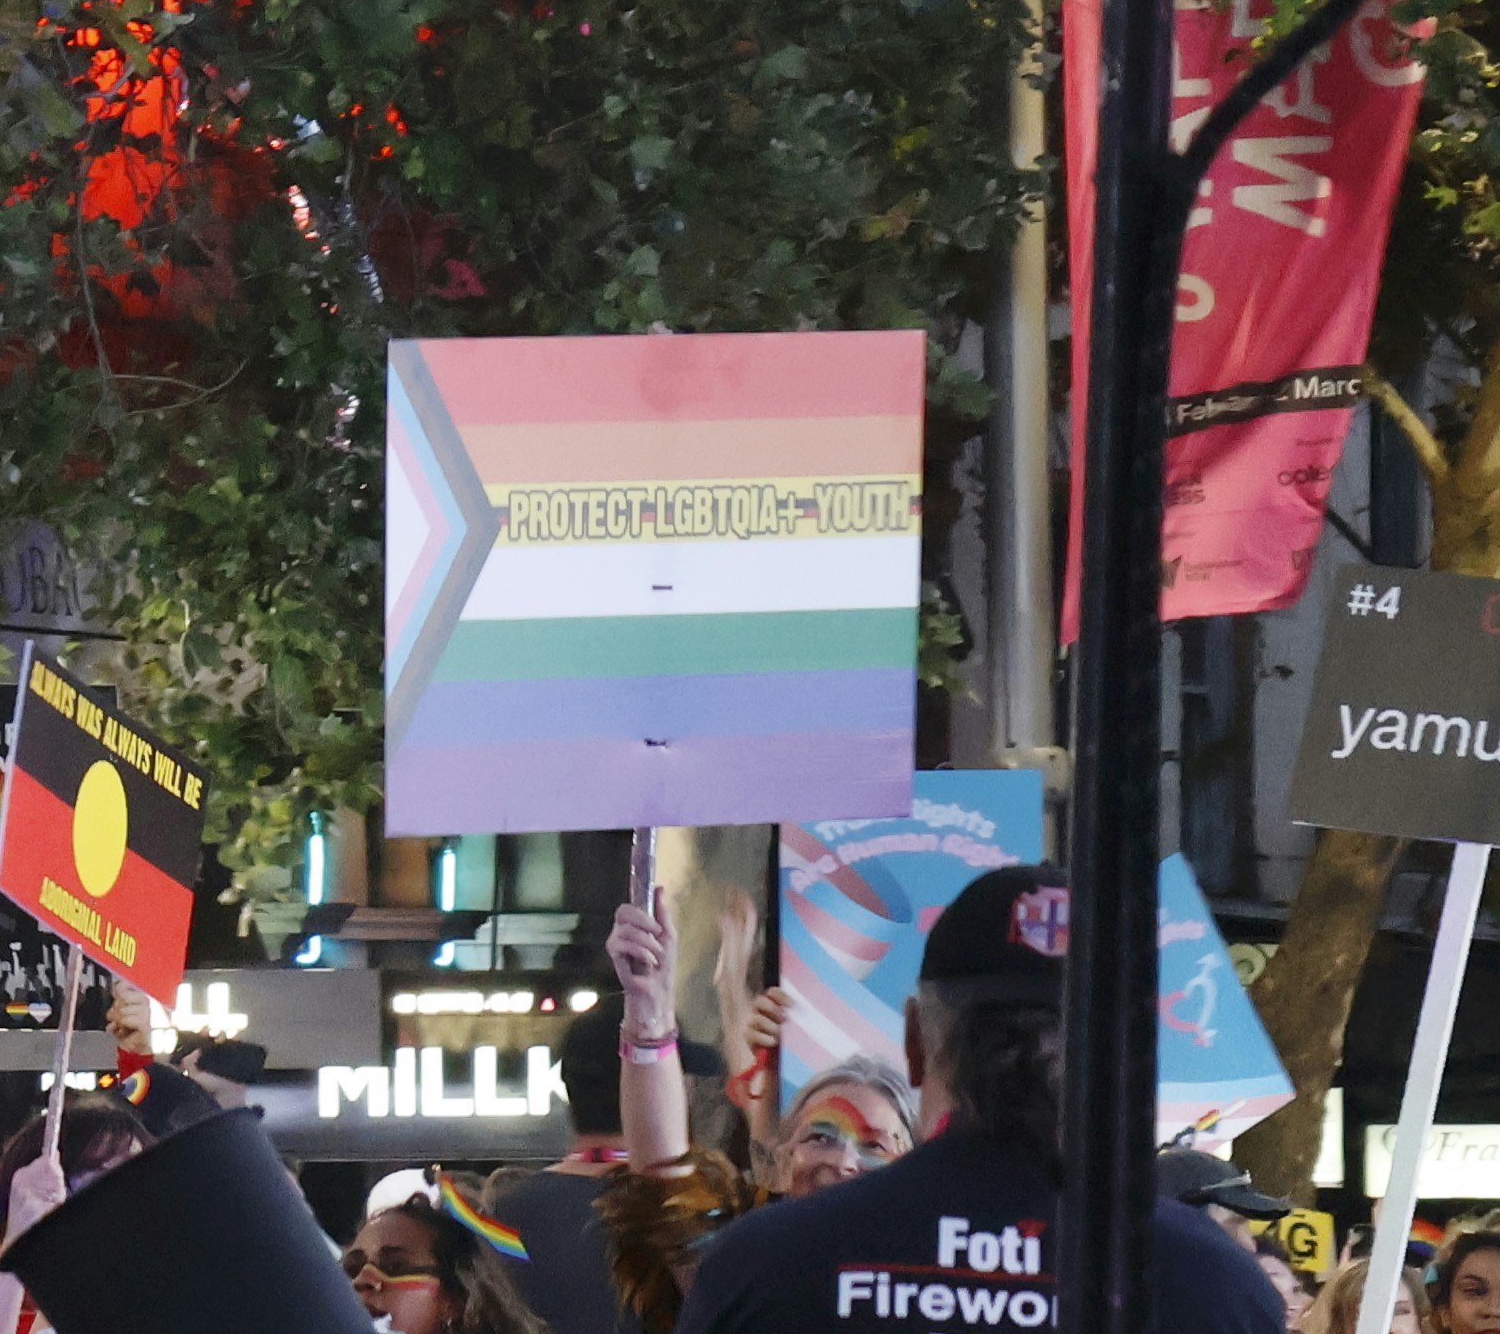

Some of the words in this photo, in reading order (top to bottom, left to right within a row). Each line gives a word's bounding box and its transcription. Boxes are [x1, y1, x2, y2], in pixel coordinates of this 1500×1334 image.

[508, 488, 647, 541] PROTECT
[654, 485, 803, 539] LGBTQIA+
[815, 480, 910, 533] YOUTH
[1348, 584, 1401, 620] #4
[30, 661, 76, 719] ALWAYS
[77, 694, 103, 739] WAS
[103, 717, 152, 774] ALWAYS
[154, 751, 181, 798] WILL
[184, 773, 202, 810] BE
[39, 876, 101, 946] ABORIGINAL
[105, 923, 136, 968] LAND
[938, 1216, 1046, 1276] Foti
